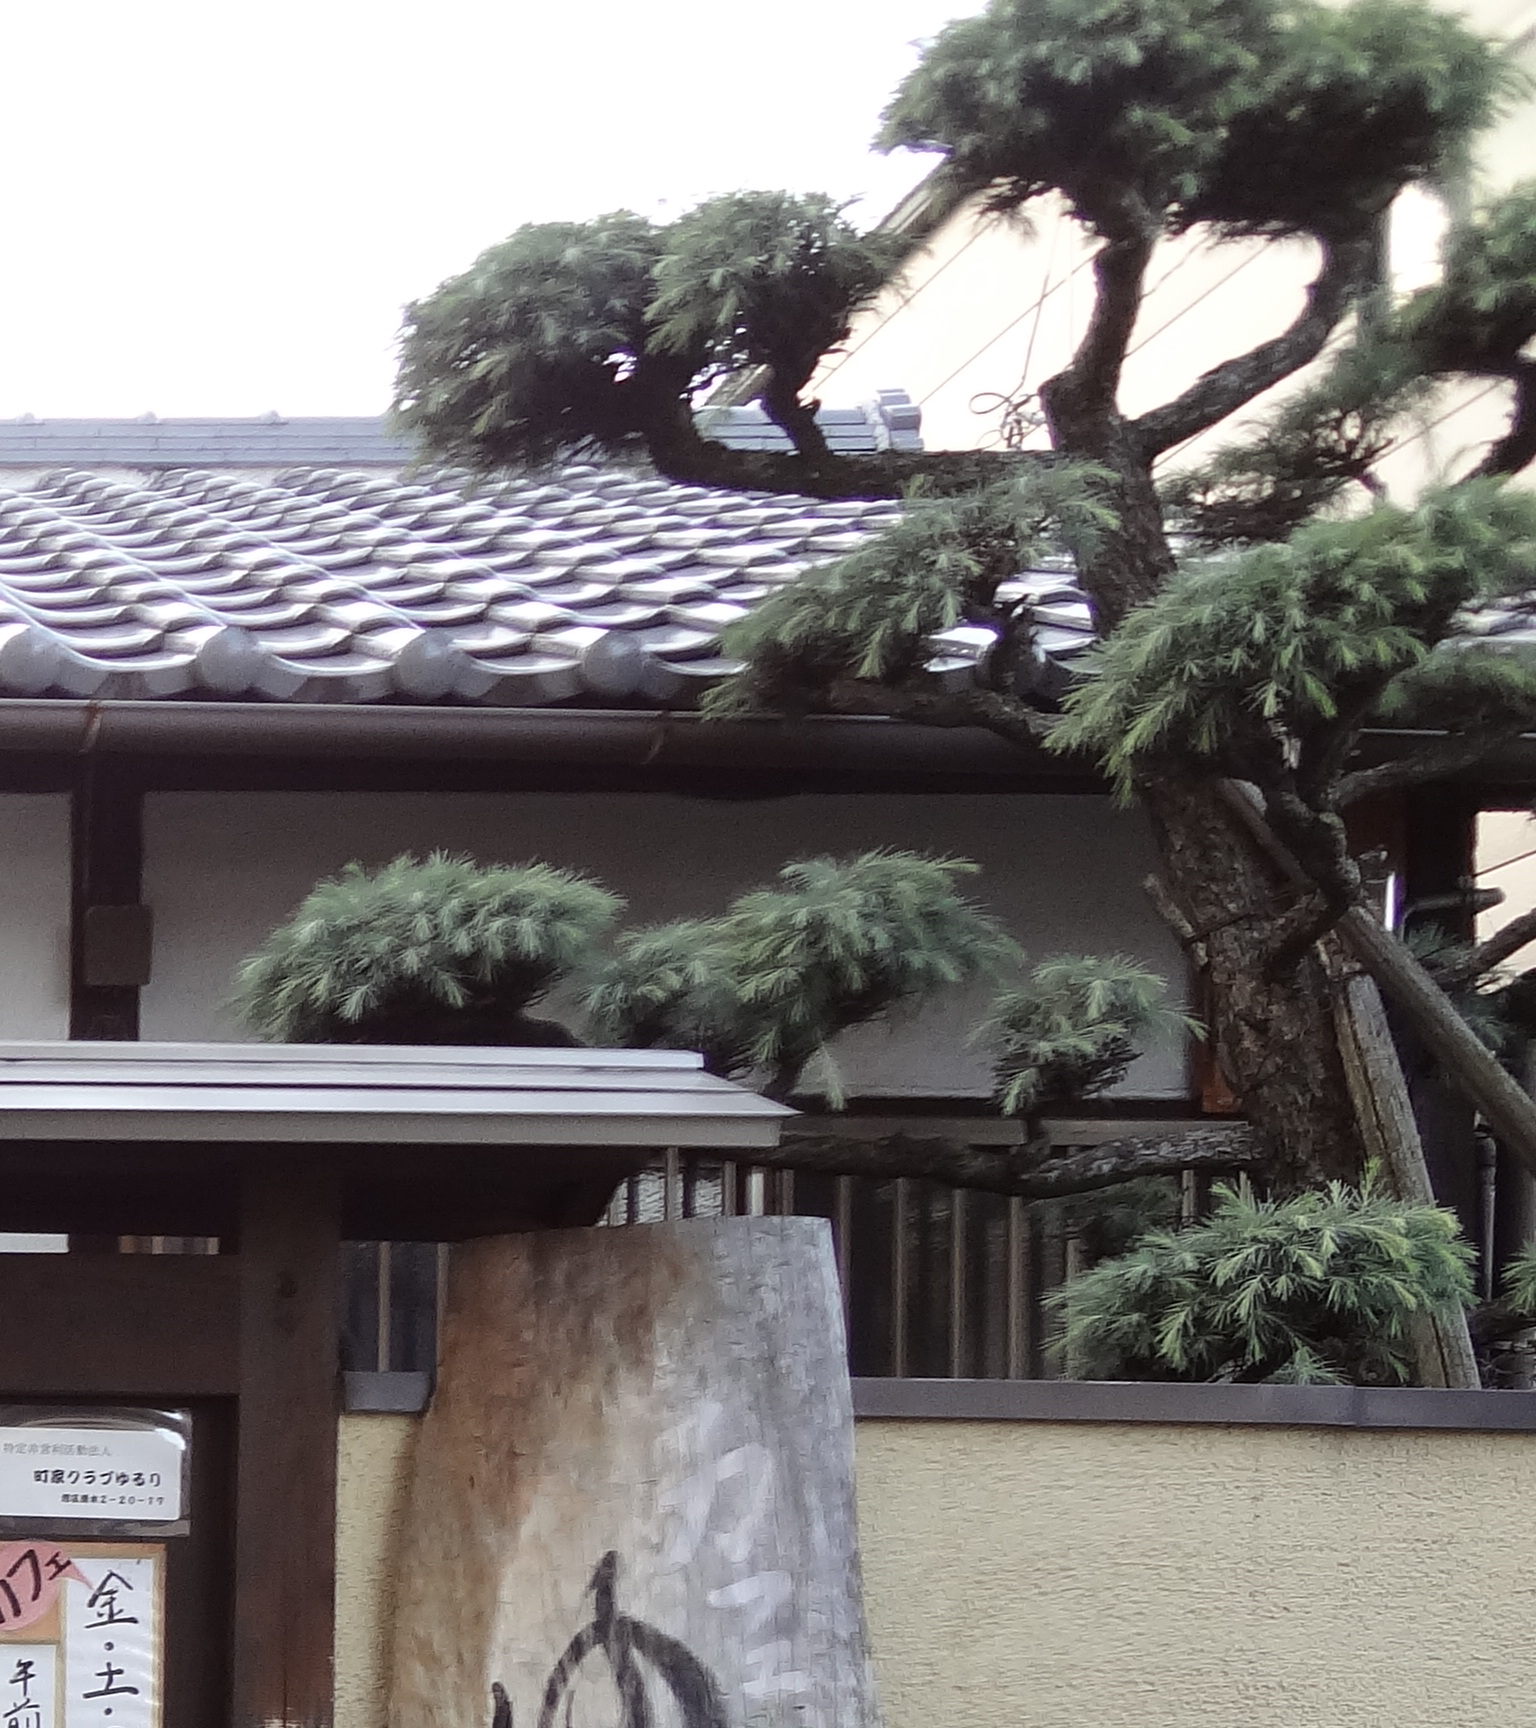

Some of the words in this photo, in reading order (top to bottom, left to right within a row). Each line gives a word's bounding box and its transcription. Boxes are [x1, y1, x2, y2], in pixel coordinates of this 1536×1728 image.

[34, 1469, 162, 1487] 町家クラブゆるり
